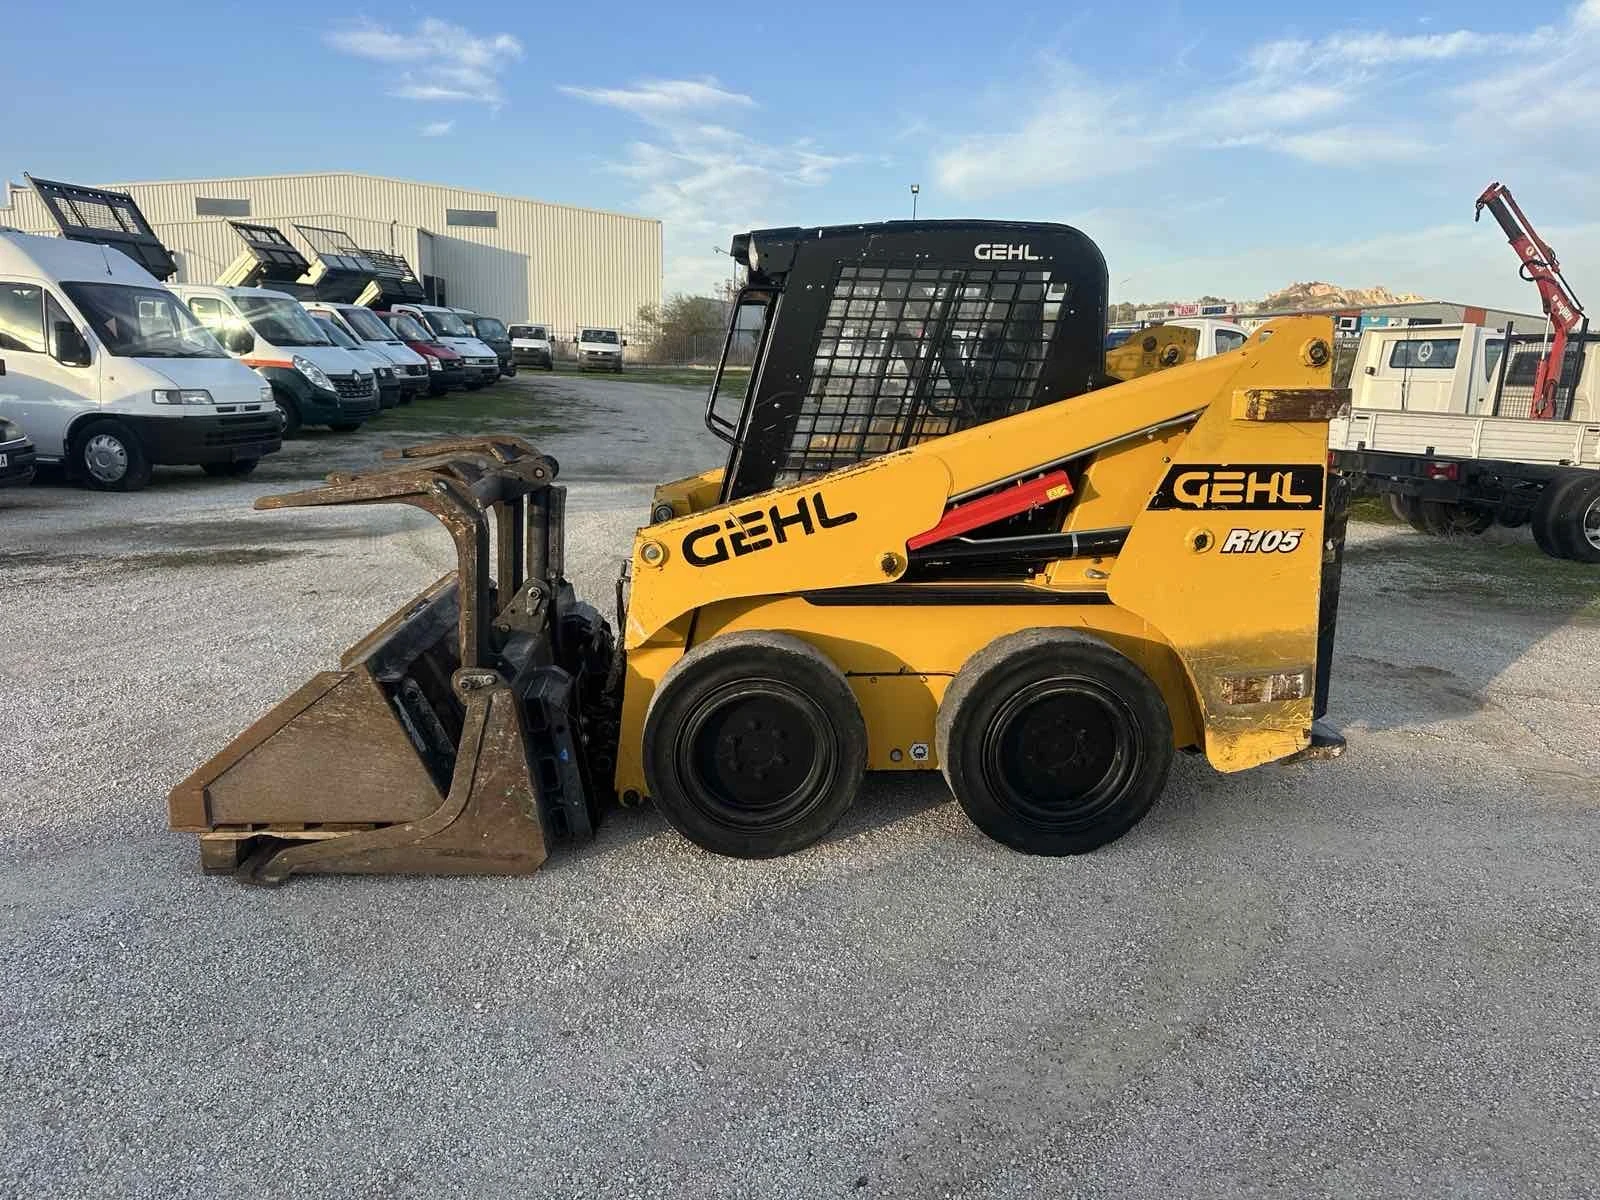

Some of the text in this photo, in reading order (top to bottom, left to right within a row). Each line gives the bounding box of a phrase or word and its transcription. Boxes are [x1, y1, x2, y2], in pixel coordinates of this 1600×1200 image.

[974, 243, 1039, 260] GEHL
[1173, 471, 1313, 505] GEHL
[682, 491, 858, 568] GEHL
[1220, 528, 1304, 554] R105
